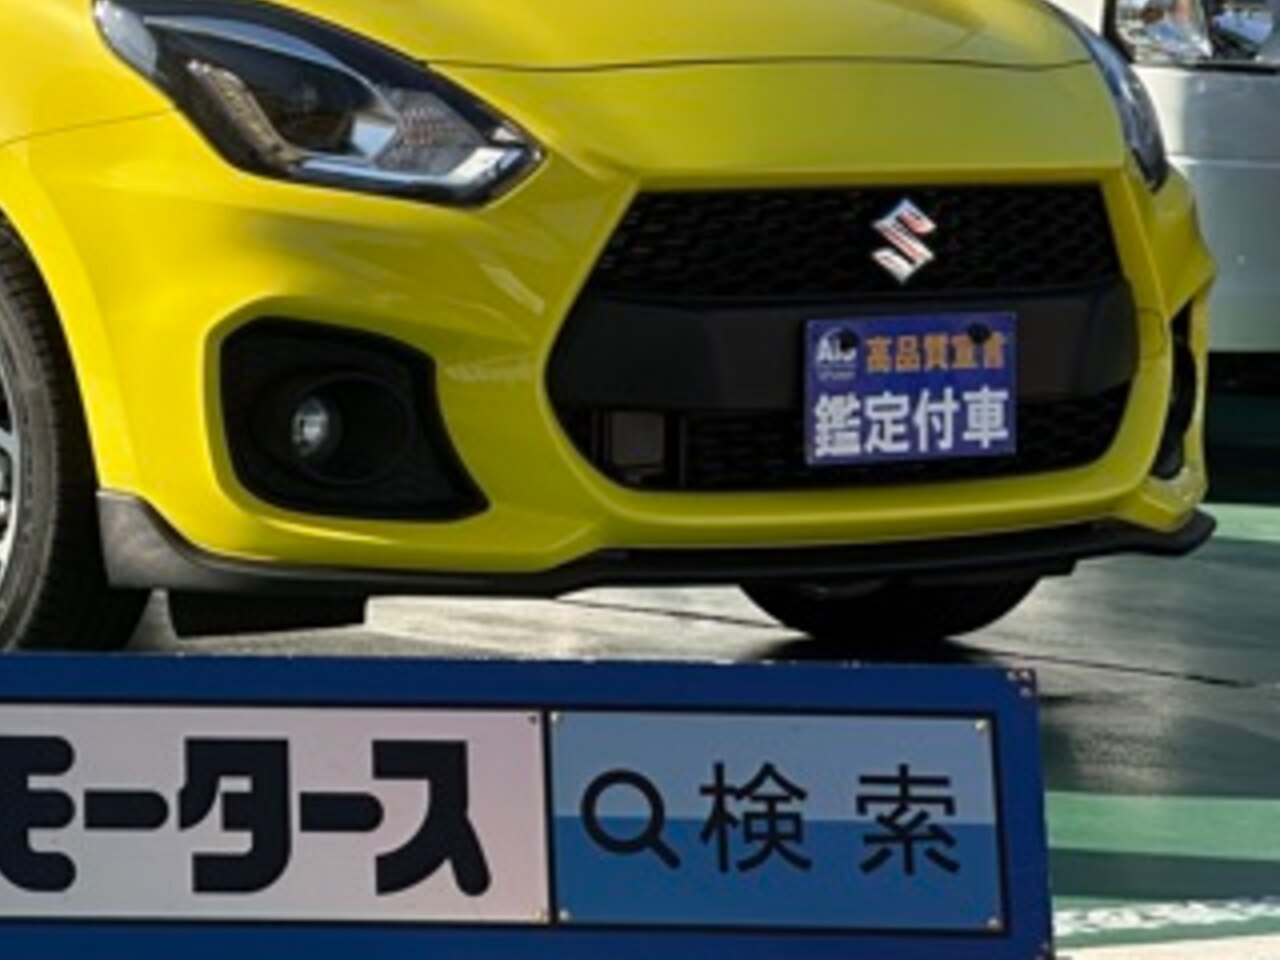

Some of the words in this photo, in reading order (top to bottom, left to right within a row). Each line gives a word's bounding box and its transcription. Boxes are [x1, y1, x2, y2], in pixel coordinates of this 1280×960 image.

[814, 386, 1009, 457] 鑑定付車
[699, 762, 961, 876] 検索
